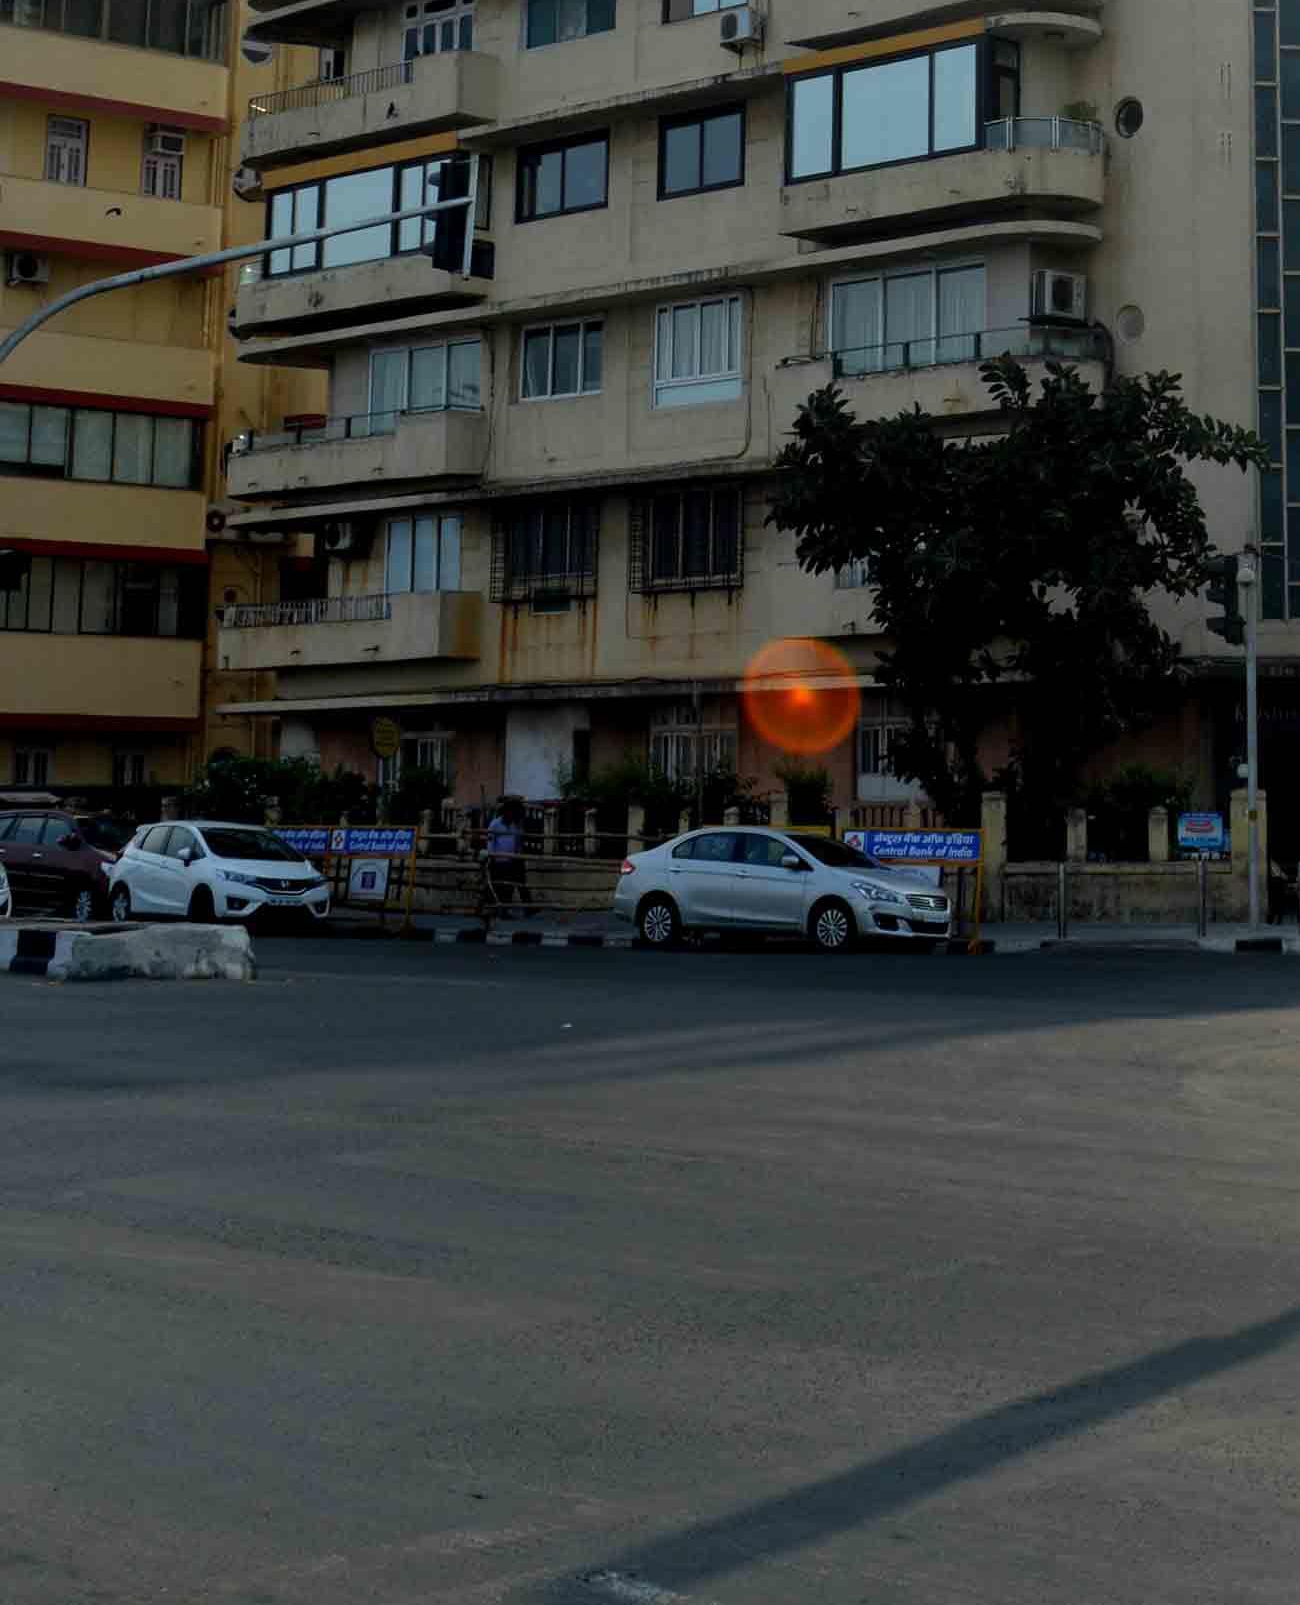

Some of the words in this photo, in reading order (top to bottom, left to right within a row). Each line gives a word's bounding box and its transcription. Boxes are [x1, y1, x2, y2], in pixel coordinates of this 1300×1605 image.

[873, 845, 908, 857] Central
[910, 845, 934, 857] Bank
[935, 846, 946, 857] of
[948, 845, 974, 858] India
